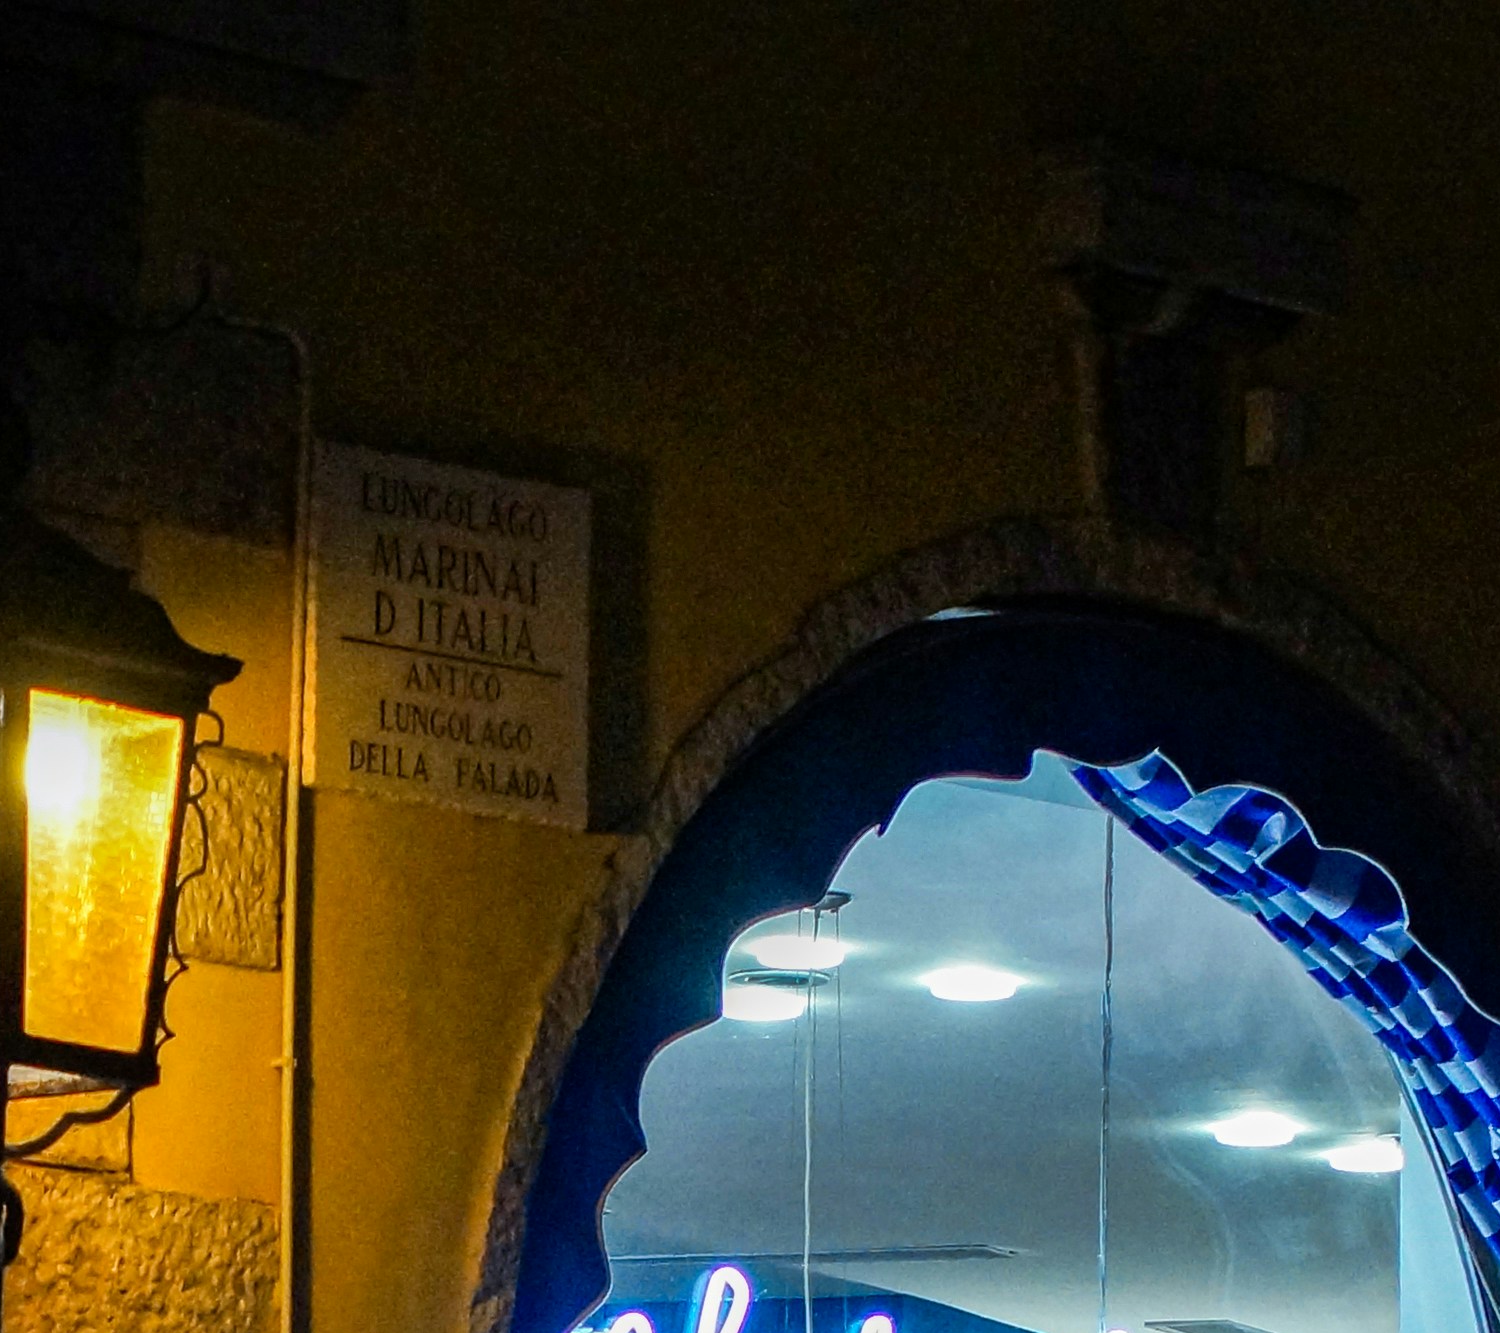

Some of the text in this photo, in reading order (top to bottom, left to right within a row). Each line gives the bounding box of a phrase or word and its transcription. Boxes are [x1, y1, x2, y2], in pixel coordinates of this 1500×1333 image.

[362, 472, 548, 543] LUNGOLAGO
[372, 533, 538, 606] MARINAI
[406, 662, 501, 701] ANTICO
[378, 700, 532, 754] LUNGOLAGO
[350, 739, 430, 783] DELLA
